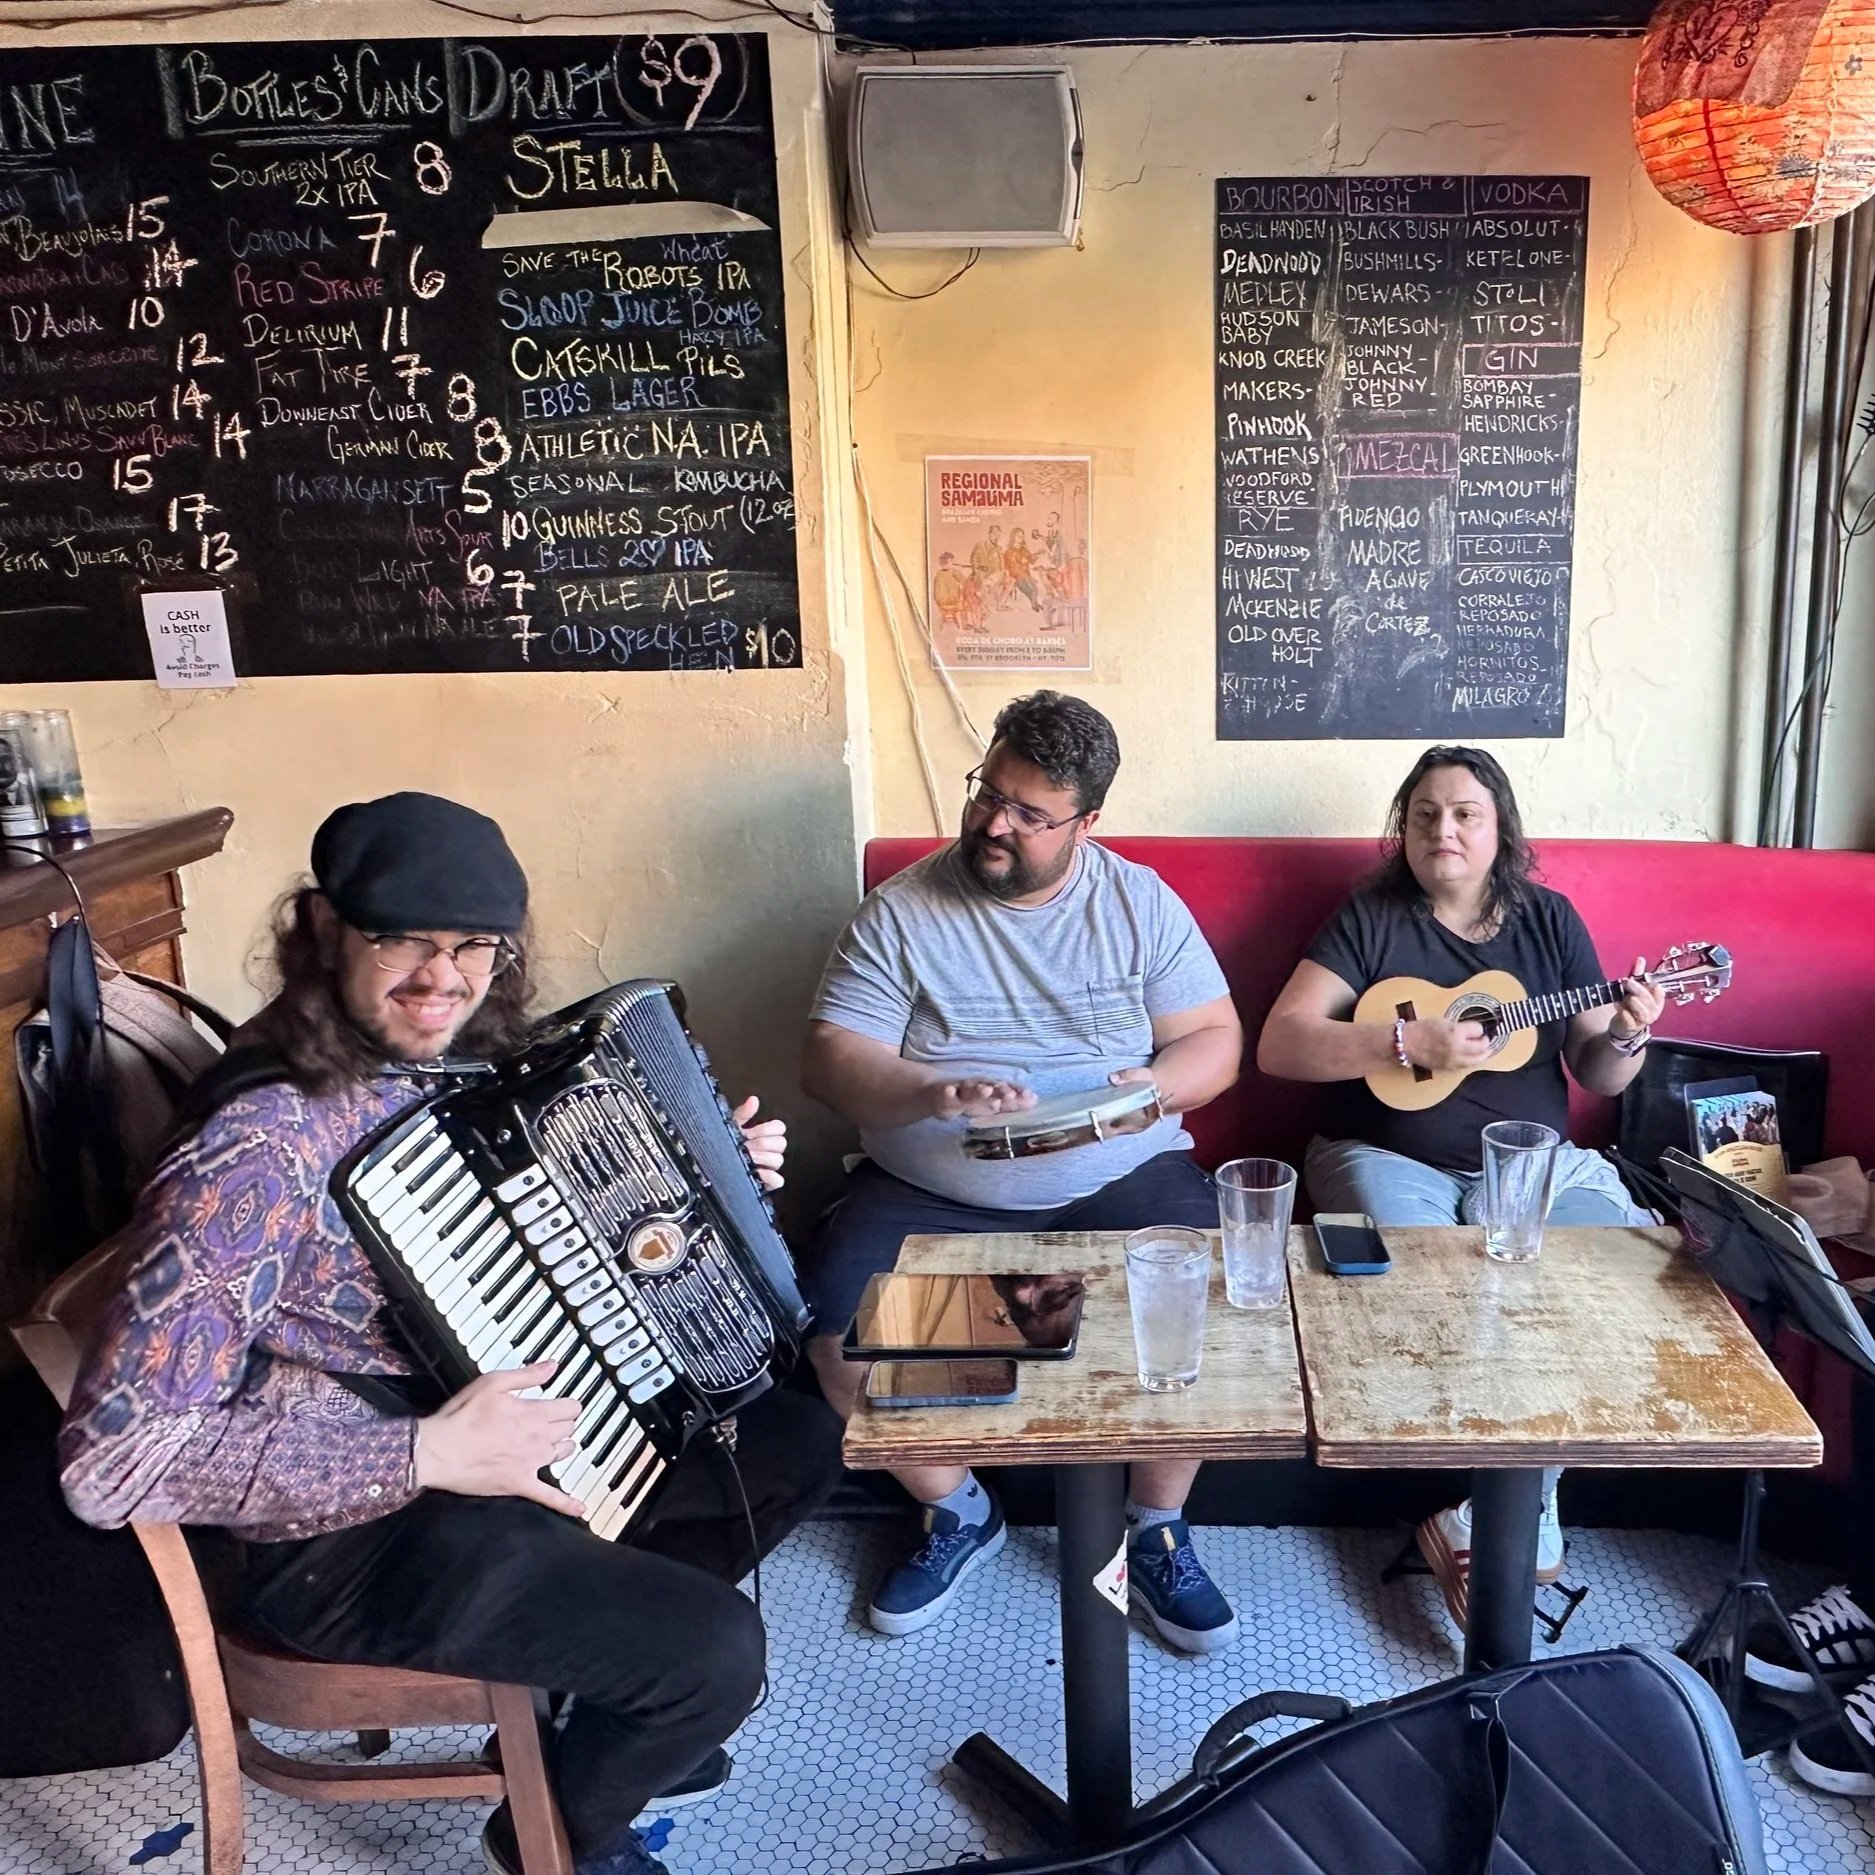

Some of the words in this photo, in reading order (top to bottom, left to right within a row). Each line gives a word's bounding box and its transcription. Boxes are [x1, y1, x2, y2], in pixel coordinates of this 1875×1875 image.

[181, 50, 342, 125] BOTTLES
[356, 45, 443, 119] CANS
[460, 44, 614, 121] DRAFT
[638, 33, 723, 132] $9
[209, 151, 329, 190] SOUTHERN
[329, 147, 392, 182] TIER
[414, 141, 452, 195] 8
[505, 134, 679, 200] STELLA
[338, 178, 378, 207] IPA
[1227, 186, 1342, 211] BOURBON
[1350, 178, 1433, 194] SCOTCH
[1481, 184, 1569, 207] VODKA
[1354, 194, 1410, 213] IRISH
[127, 196, 171, 242] 15
[1220, 223, 1267, 241] BASIL
[1270, 219, 1326, 241] HAYDEN
[1345, 220, 1399, 242] BLACK
[1407, 219, 1450, 240] BUSH
[227, 218, 338, 258] CORONA
[346, 213, 396, 269] 7
[502, 252, 556, 278] SAVE
[566, 250, 602, 268] THE
[604, 251, 703, 293] ROBOTS
[717, 260, 751, 290] IPA
[1221, 247, 1322, 278] DEADWOOD
[1466, 250, 1525, 269] KETEL
[234, 262, 293, 307] RED
[300, 262, 384, 305] STRIPE
[410, 245, 446, 299] 6
[1223, 280, 1308, 307] MEDLEY
[1474, 280, 1545, 307] STOLI
[129, 297, 165, 331] 10
[498, 288, 595, 331] SLOOP
[600, 290, 683, 329] JUICE
[687, 287, 762, 328] BOMB
[1221, 311, 1301, 327] HUDSON
[242, 313, 362, 352] DELIRIUM
[1222, 325, 1274, 345] BABY
[176, 331, 225, 373] 12
[512, 336, 671, 380] CATSKILL
[1219, 348, 1267, 370] KNOB
[1274, 346, 1326, 369] CREEK
[1345, 343, 1413, 361] JOHNNY
[1485, 347, 1539, 370] GIN
[255, 348, 305, 394] FAT
[301, 345, 372, 394] TIRE
[391, 352, 434, 400] 7
[1347, 359, 1417, 378] BLACK
[521, 381, 591, 420] EBBS
[610, 375, 708, 412] LAGER
[1344, 376, 1428, 393] JOHNNY
[1463, 379, 1534, 396] BOMBAY
[172, 378, 213, 421] 14
[256, 397, 363, 429] DOWNEAST
[369, 385, 433, 424] CIDER
[447, 371, 478, 422] 8
[1352, 392, 1404, 408] RED
[1461, 393, 1545, 410] SAPPHIRE
[214, 411, 251, 460] 14
[1228, 411, 1312, 440] PINHOOK
[327, 424, 400, 465] GERMAN
[407, 429, 455, 461] CIDER
[474, 416, 512, 473] 8
[520, 429, 645, 463] ATHLETIC
[720, 420, 771, 460] IPA
[1220, 446, 1320, 471] WATHENS
[1355, 440, 1458, 473] MEZCAL
[112, 453, 154, 495] 15
[508, 472, 645, 498] SEASONAL
[941, 473, 1022, 490] REGIONAL
[461, 468, 494, 515] 5
[1460, 479, 1561, 498] PLYMOUTH
[168, 493, 222, 533] 17
[501, 509, 530, 550] 10
[532, 506, 644, 546] GUINNESS
[652, 504, 735, 538] STOUT
[1239, 508, 1295, 532] RYE
[200, 531, 238, 571] 13
[533, 541, 609, 572] BELLS
[674, 539, 714, 567] IPA
[1224, 539, 1311, 561] DEADWOOD
[1347, 538, 1422, 567] MADRE
[1463, 538, 1553, 557] TEQUILA
[465, 549, 496, 587] 6
[1243, 566, 1301, 593] WEST
[1365, 567, 1431, 592] AGAVE
[1458, 567, 1508, 588] CASCO
[1509, 569, 1553, 588] VIEJO
[501, 570, 536, 609] 7
[557, 580, 642, 617] PALE
[662, 569, 736, 613] ALE
[167, 610, 199, 621] CASH
[173, 623, 211, 634] better
[1459, 608, 1542, 623] REPOSADO
[502, 614, 547, 663] 7
[551, 624, 605, 655] OLD
[609, 621, 737, 664] SPECKLED
[745, 617, 796, 669] $10
[1228, 624, 1267, 644] OLD
[1271, 626, 1320, 645] OVER
[669, 647, 736, 674] HEN
[1271, 644, 1323, 668] HOLT
